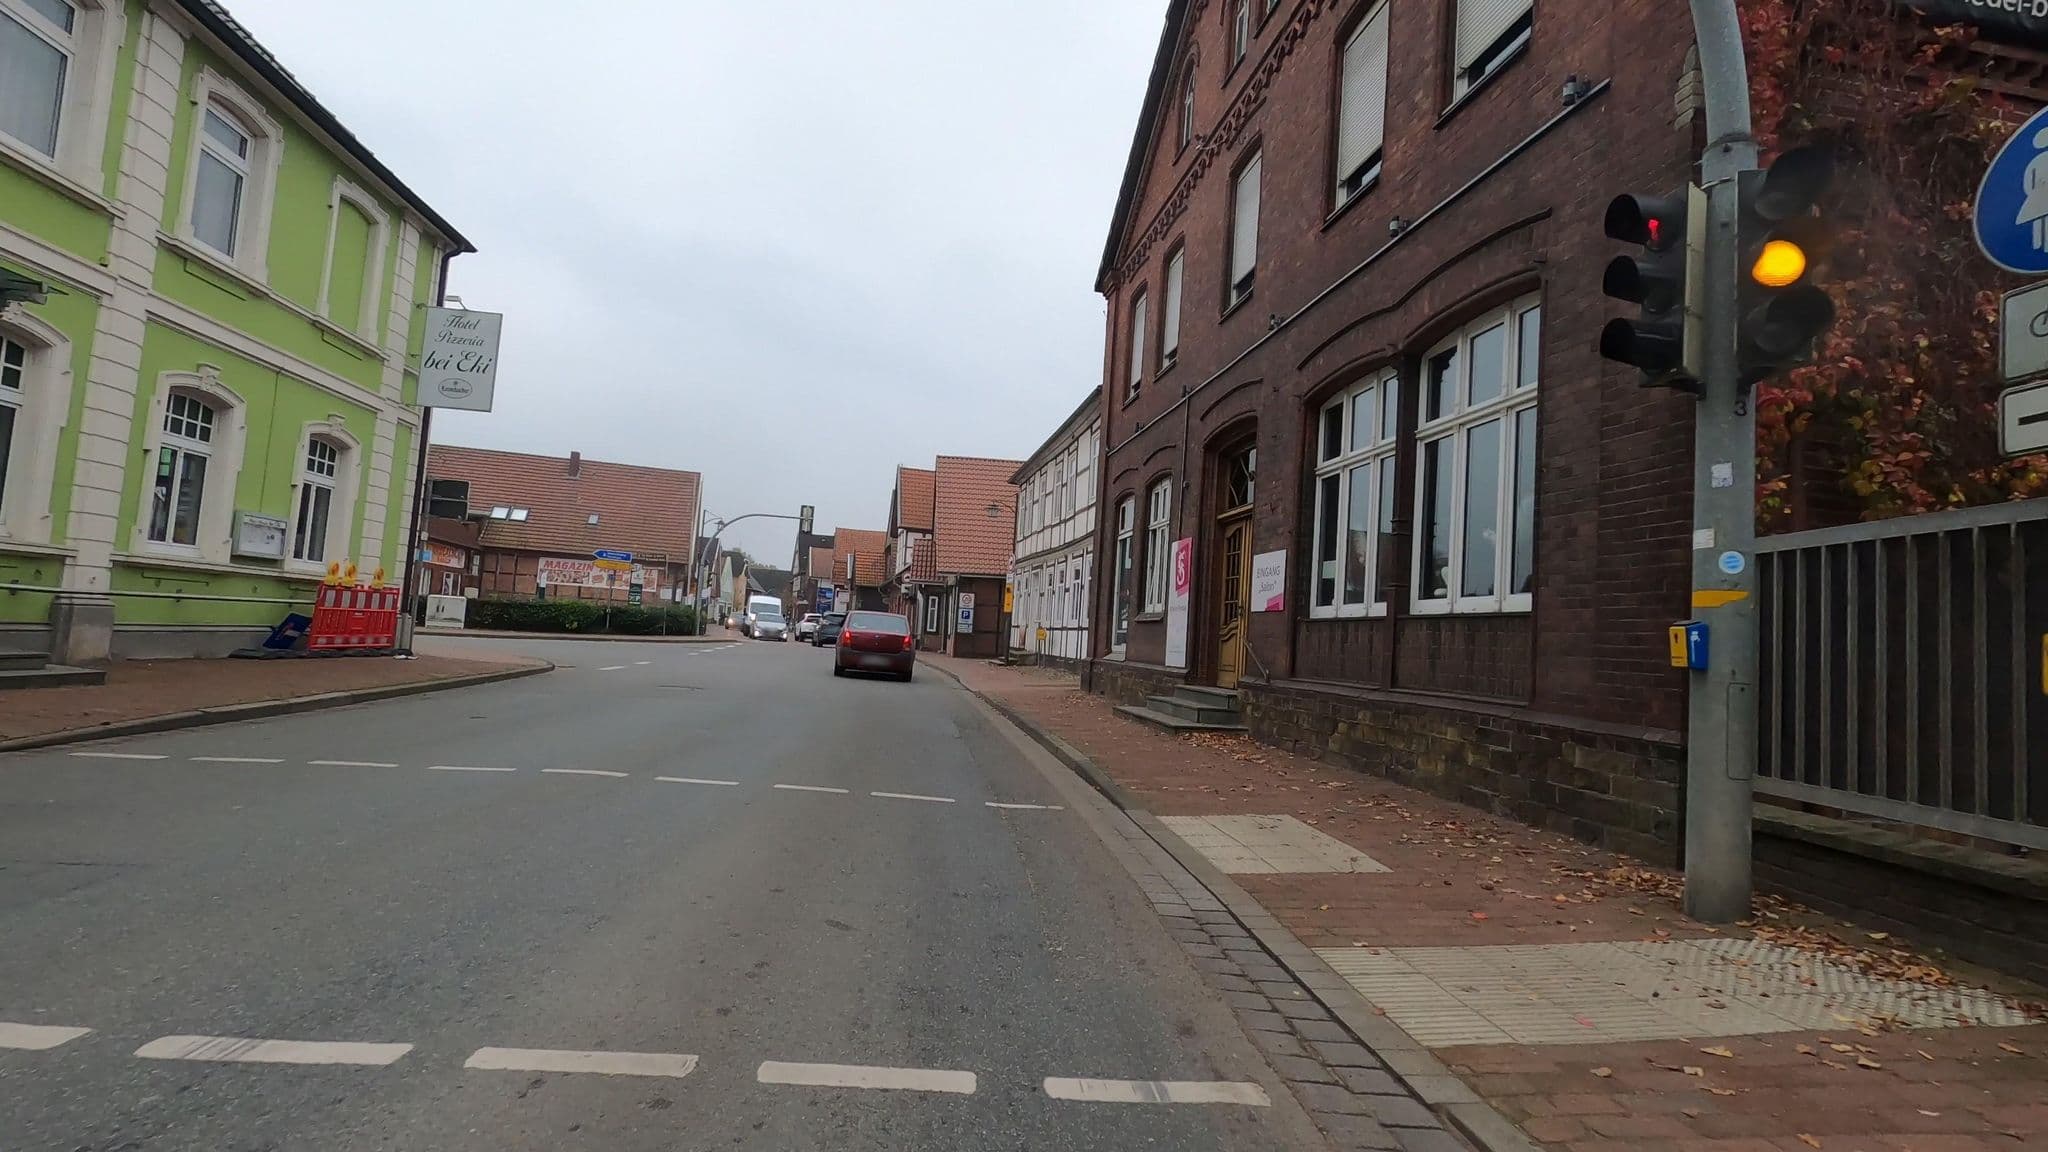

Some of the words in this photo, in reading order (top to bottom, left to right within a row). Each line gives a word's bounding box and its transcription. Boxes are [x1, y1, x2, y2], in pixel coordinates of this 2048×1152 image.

[443, 315, 481, 330] Hotel
[434, 330, 486, 347] Pizzeria
[424, 350, 453, 370] bei
[457, 351, 492, 374] Eki
[1734, 400, 1747, 416] 3
[543, 559, 594, 573] MAGAZIN
[1255, 565, 1281, 579] EINGANG
